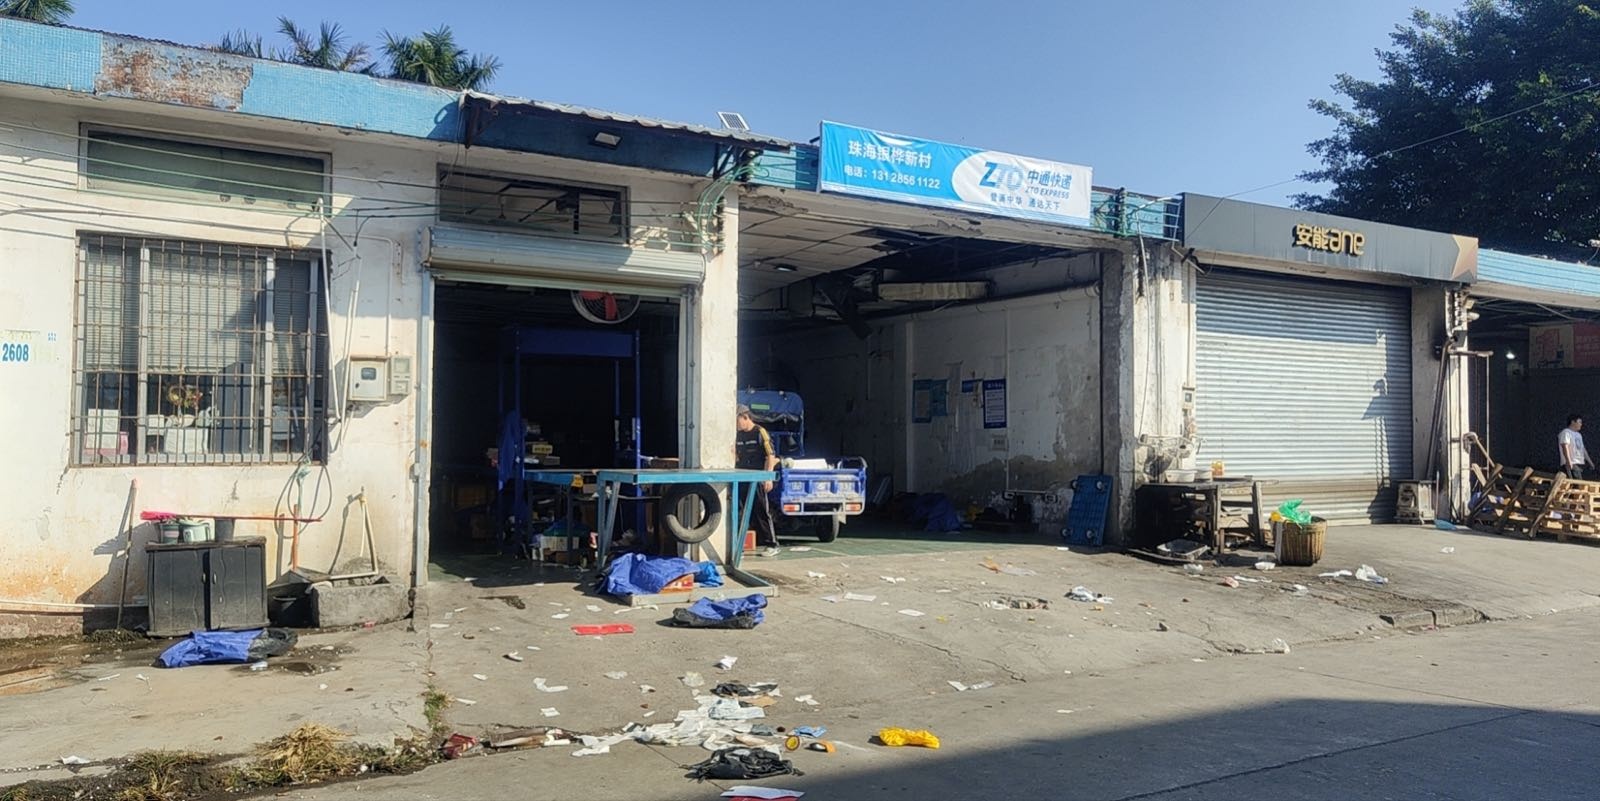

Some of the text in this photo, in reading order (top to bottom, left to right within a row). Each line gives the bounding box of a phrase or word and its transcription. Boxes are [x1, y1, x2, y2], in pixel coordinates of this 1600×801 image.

[872, 169, 889, 182] 131
[917, 177, 941, 190] 1122
[1027, 169, 1072, 190] 中通快递
[1024, 185, 1070, 200] ZTO EXPRESS
[2, 342, 29, 362] 2608
